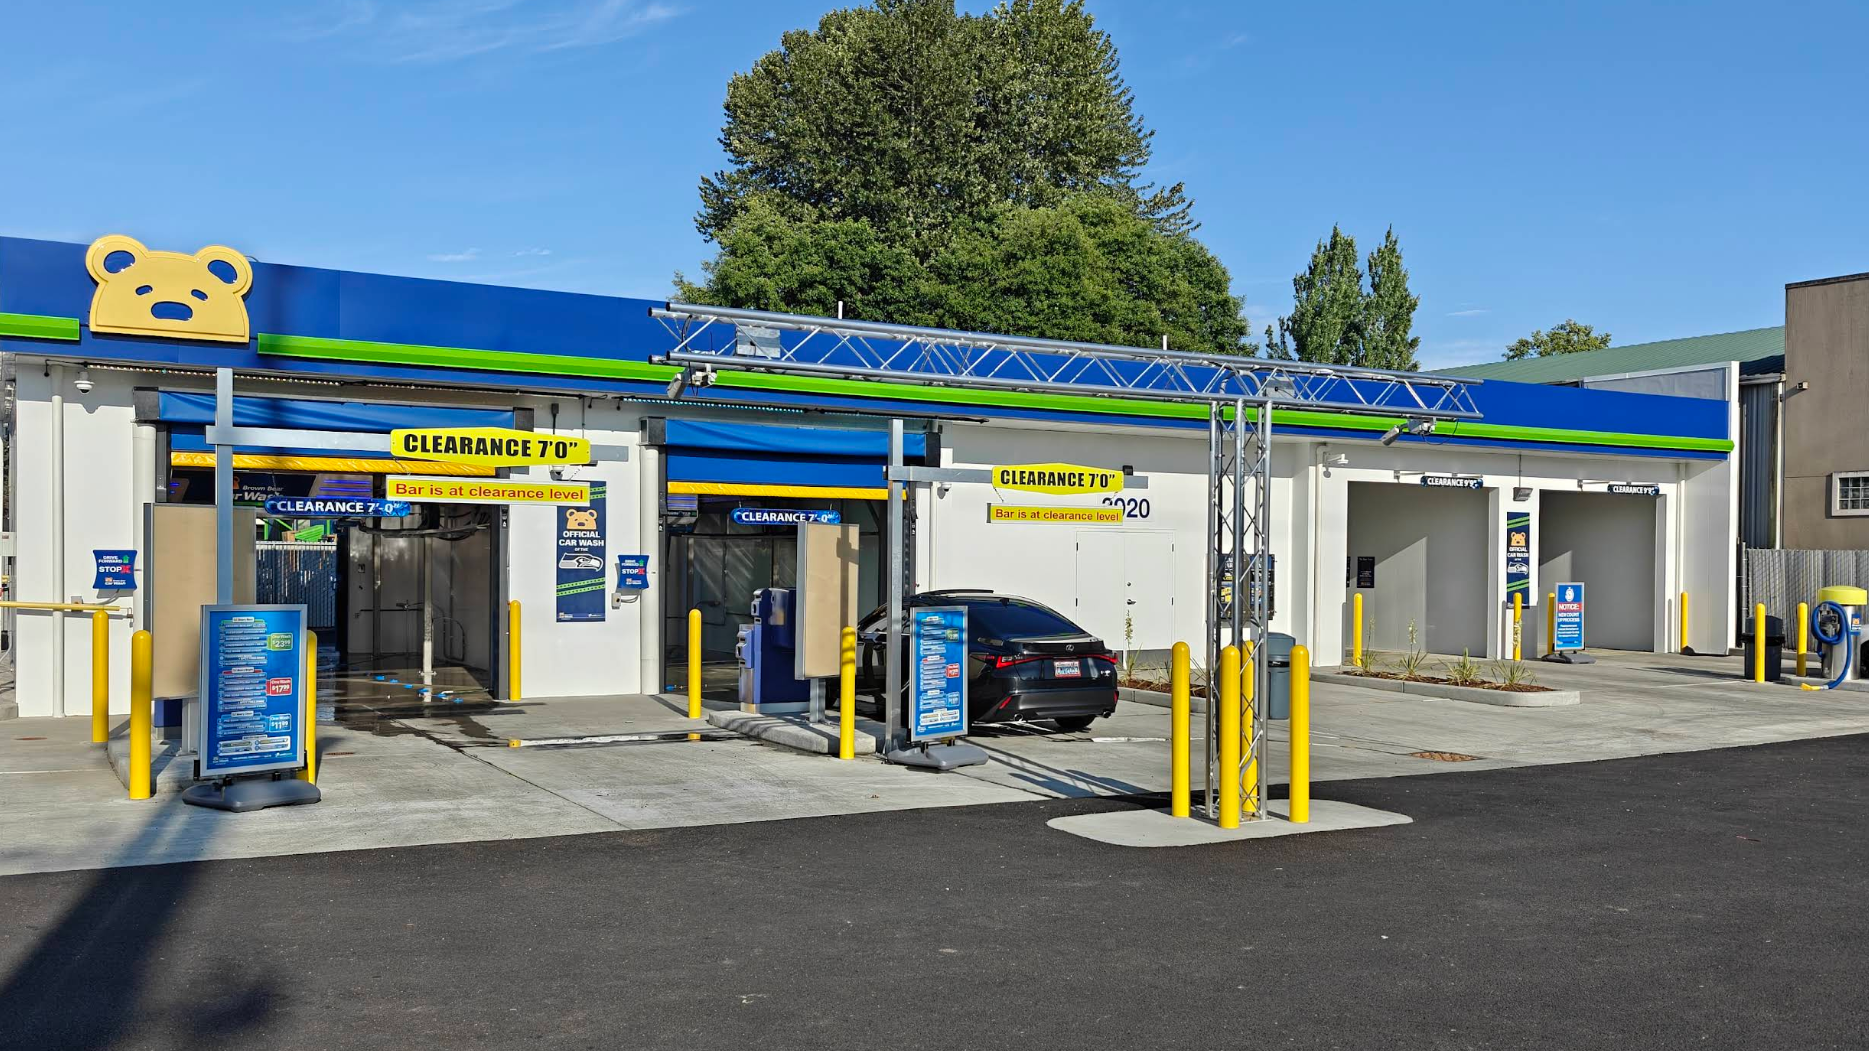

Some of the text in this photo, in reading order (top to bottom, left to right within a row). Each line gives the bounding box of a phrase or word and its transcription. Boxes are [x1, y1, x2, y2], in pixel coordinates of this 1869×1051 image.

[403, 433, 531, 457] CLEARANCE
[1000, 469, 1084, 487] CLEARANCE
[1427, 477, 1463, 487] CLEARANCE
[395, 483, 583, 500] Bar is at clearance level
[1612, 486, 1643, 494] CLEARANCE
[277, 500, 364, 513] CLEARANCE
[741, 511, 806, 521] CLEARANCE
[995, 507, 1119, 521] Bar is at clearance level
[563, 530, 600, 538] OFFICIAL
[578, 539, 604, 547] WASH
